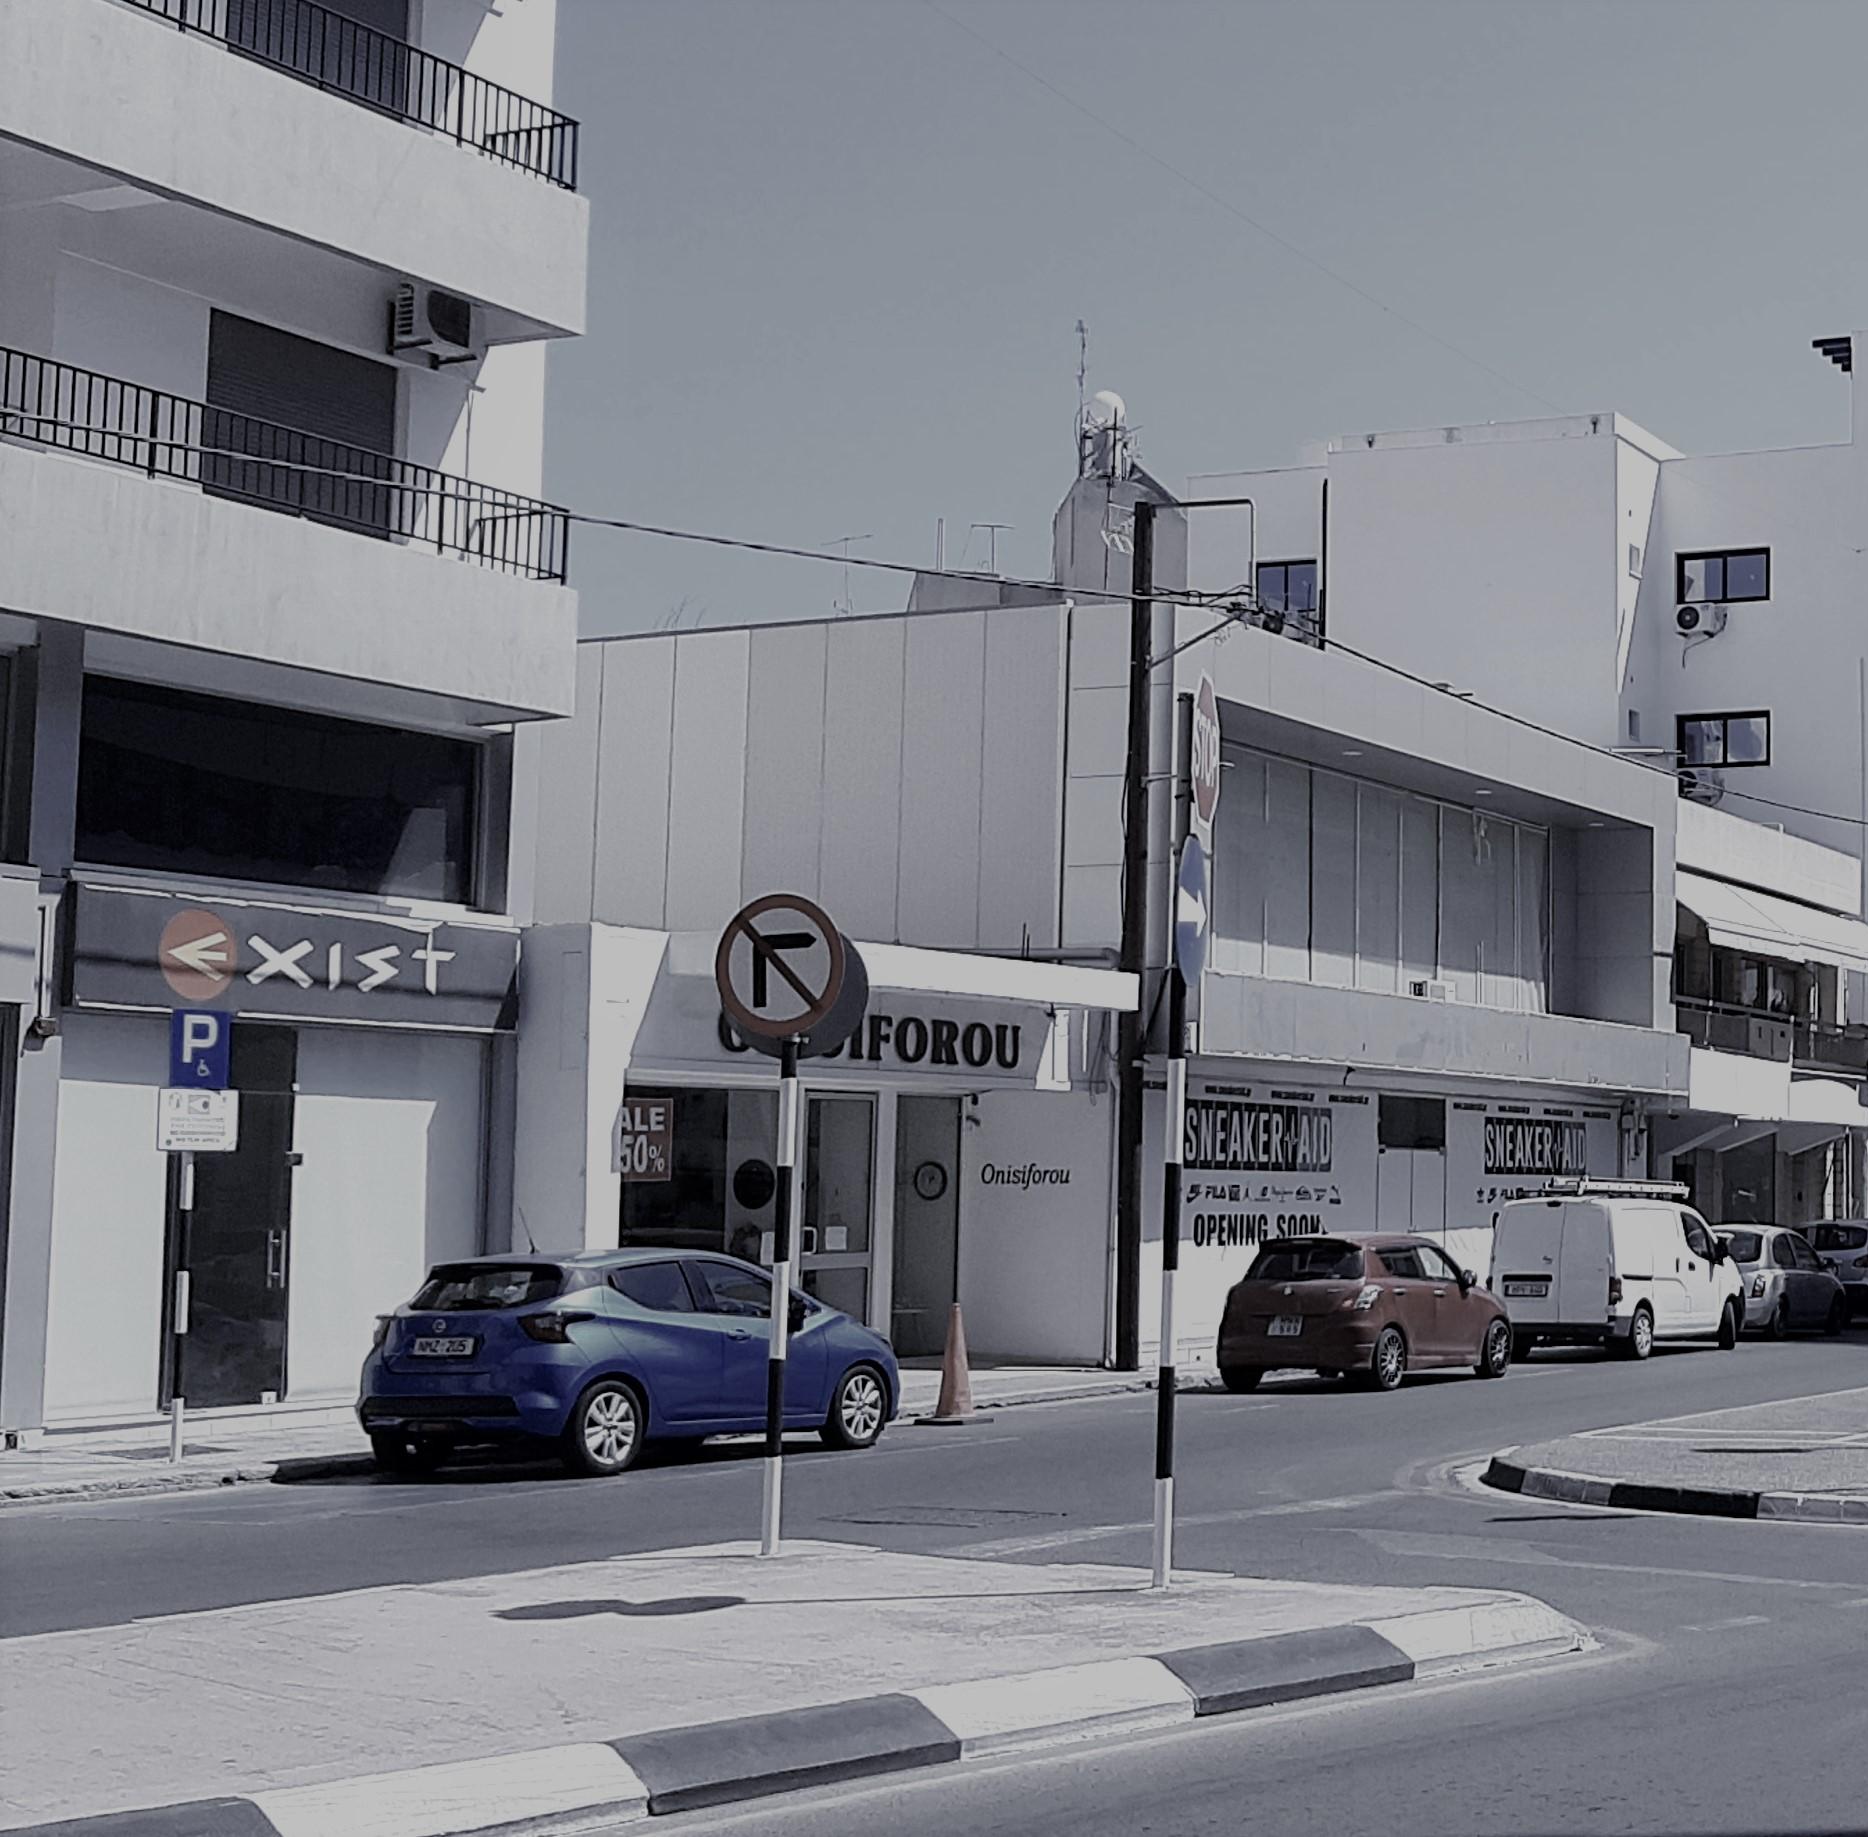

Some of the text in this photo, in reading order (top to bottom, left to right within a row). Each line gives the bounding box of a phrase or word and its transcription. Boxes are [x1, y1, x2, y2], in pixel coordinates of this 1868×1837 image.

[182, 1014, 218, 1063] P
[621, 1107, 665, 1131] ALE
[1185, 1106, 1333, 1165] SNEAKER AID
[1486, 1122, 1586, 1171] SNEAKER AID
[981, 1163, 1070, 1191] Onisiforou
[1206, 1185, 1227, 1199] FILA
[1193, 1213, 1269, 1247] OPENING
